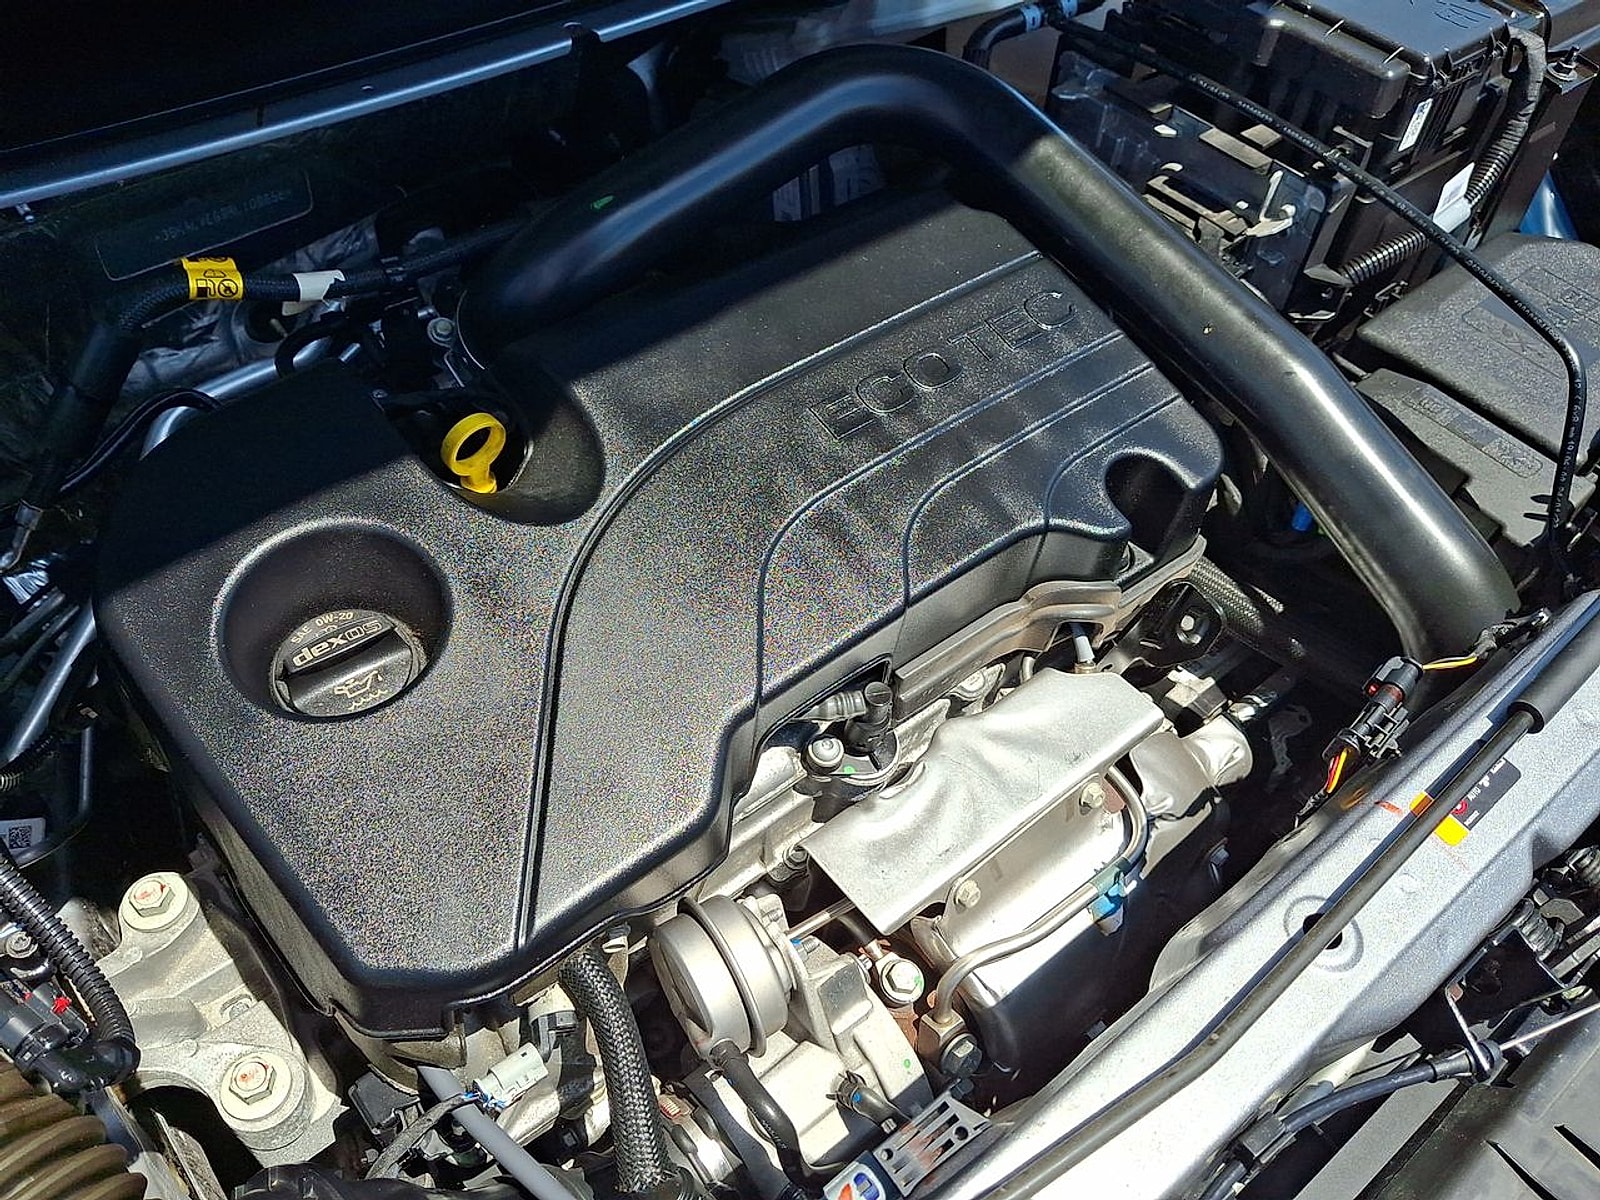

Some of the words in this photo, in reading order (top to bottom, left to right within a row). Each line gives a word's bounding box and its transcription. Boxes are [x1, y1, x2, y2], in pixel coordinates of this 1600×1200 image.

[806, 290, 1078, 440] ECOTEC
[290, 626, 313, 645] SAE
[316, 611, 354, 627] 0W-20
[292, 619, 383, 667] dexos
